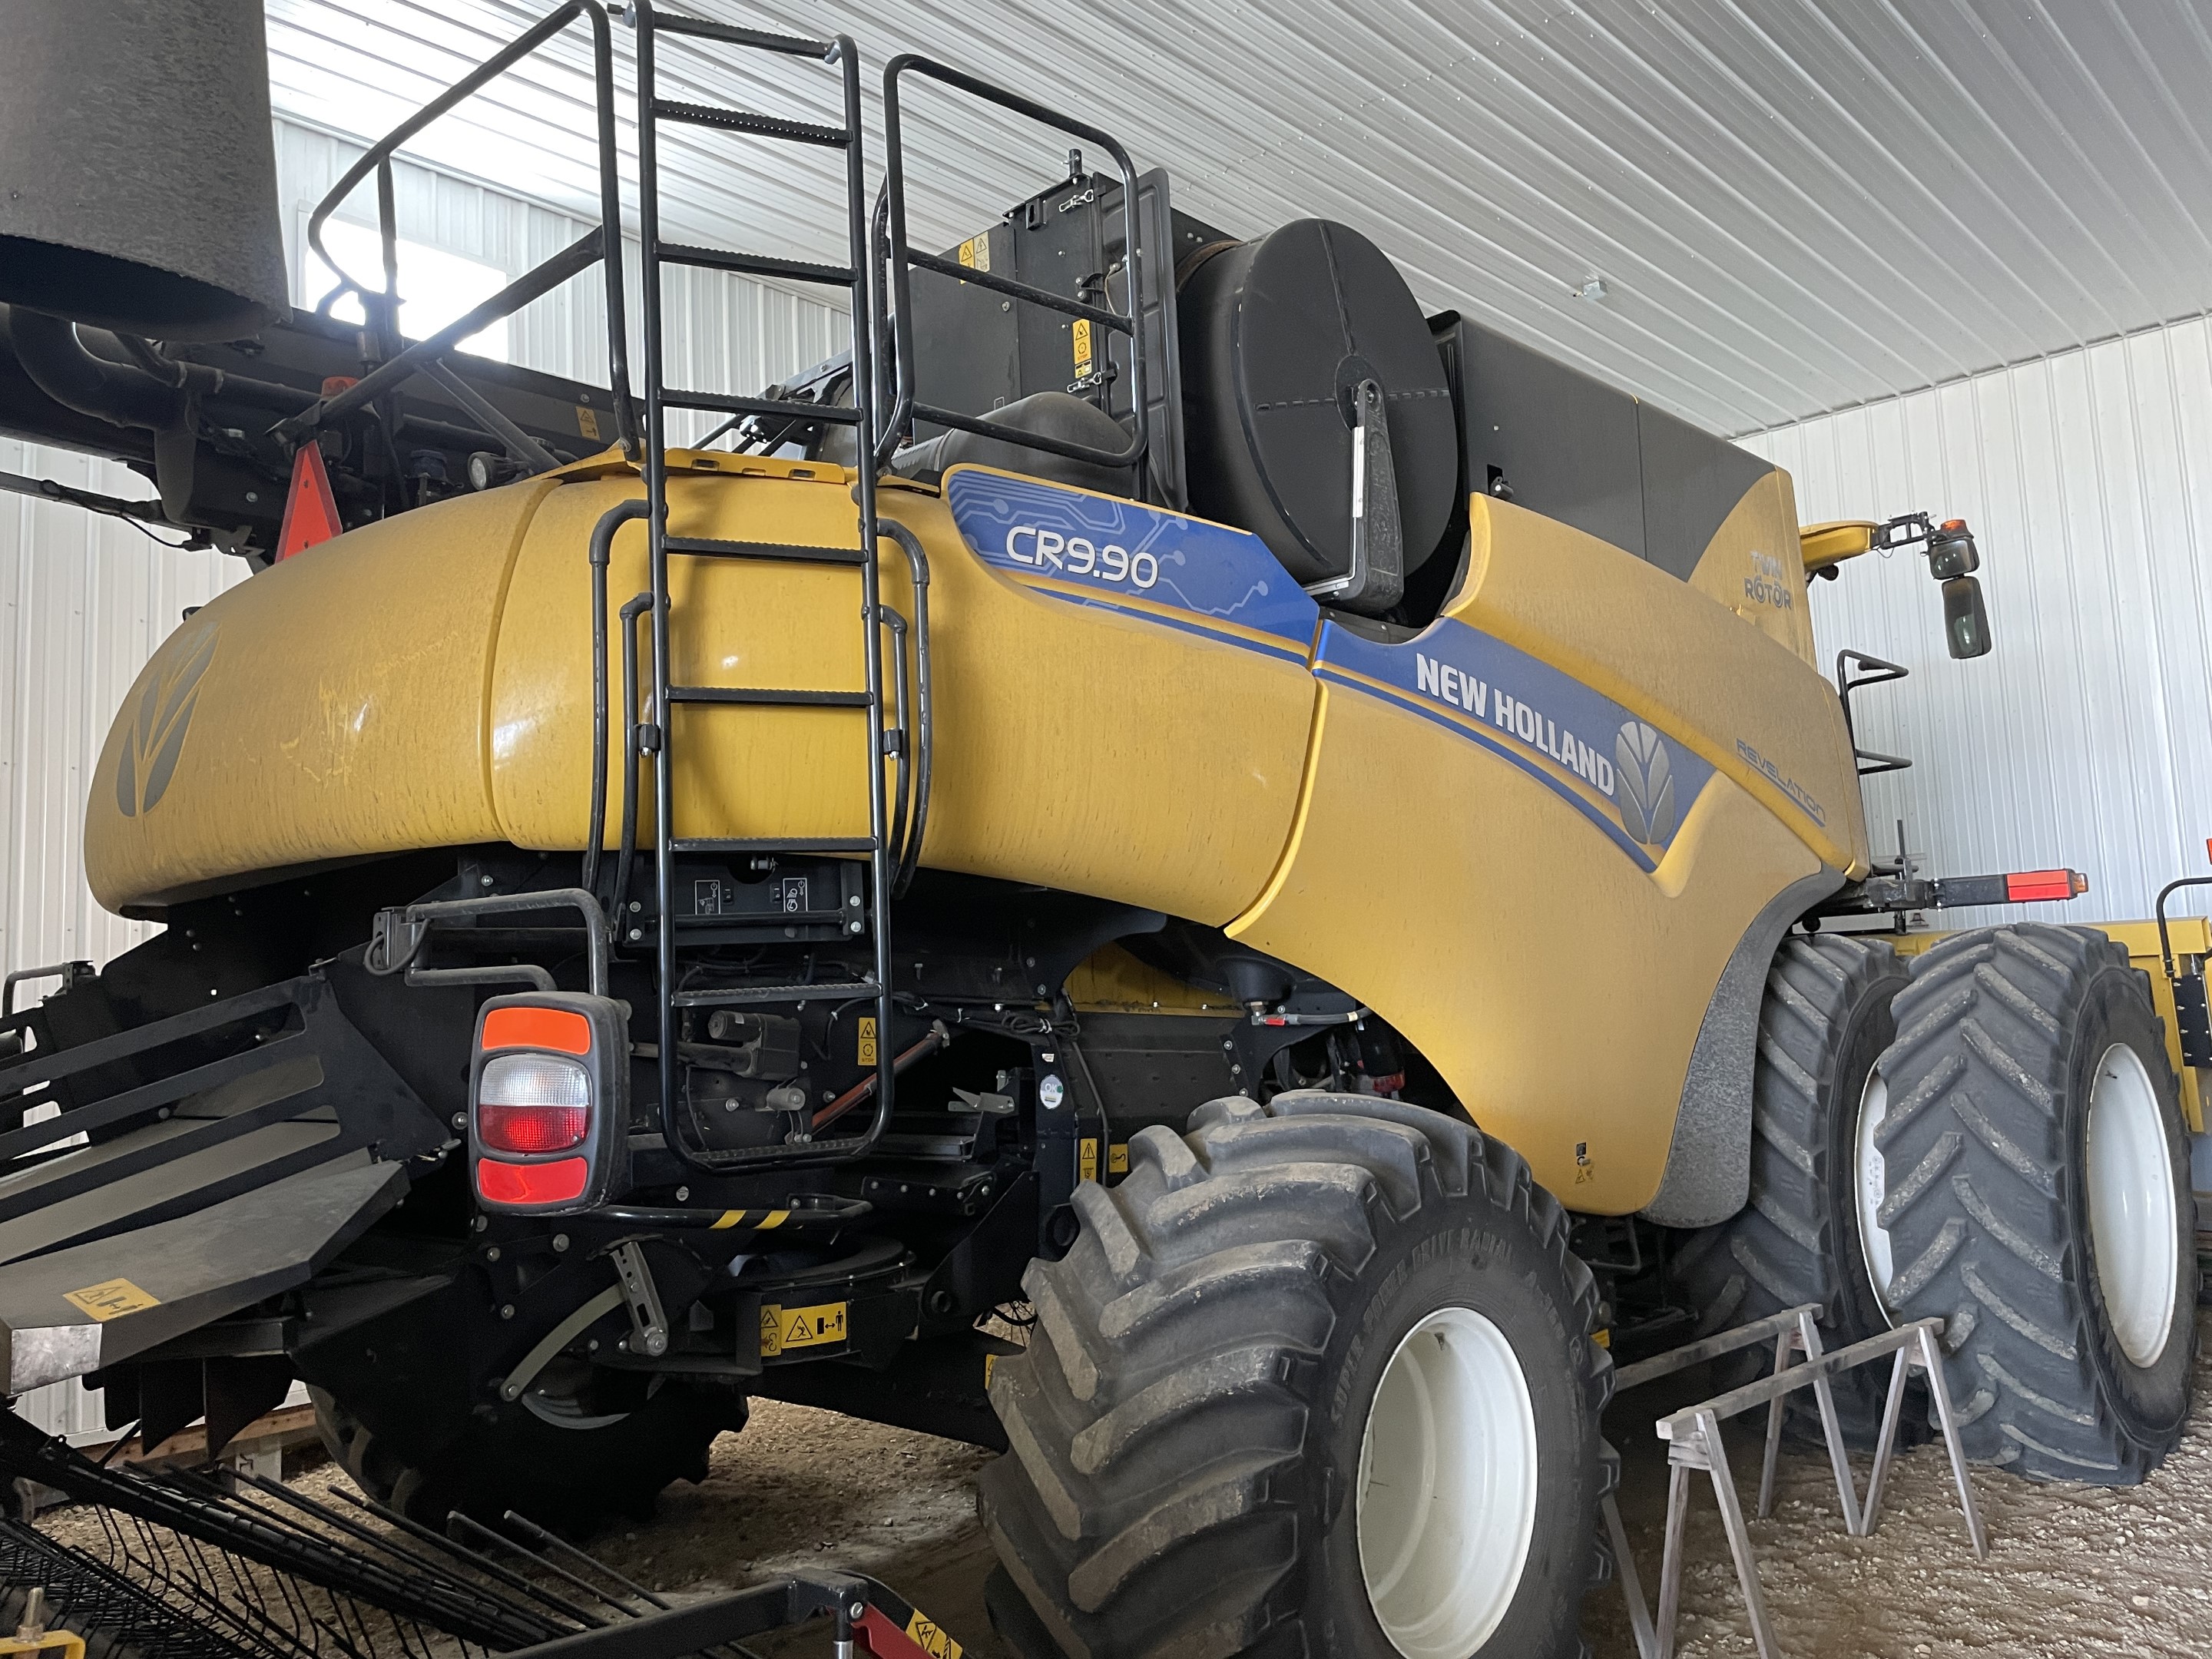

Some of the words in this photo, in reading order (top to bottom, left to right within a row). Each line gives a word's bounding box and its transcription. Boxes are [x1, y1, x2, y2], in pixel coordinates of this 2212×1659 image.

[1006, 525, 1158, 588] CR9.90
[1743, 575, 1792, 611] ROTOR
[1416, 653, 1487, 718] NEW
[1495, 688, 1614, 796] HOLLAND
[1736, 737, 1826, 823] REVELATION
[1045, 1083, 1058, 1093] OK
